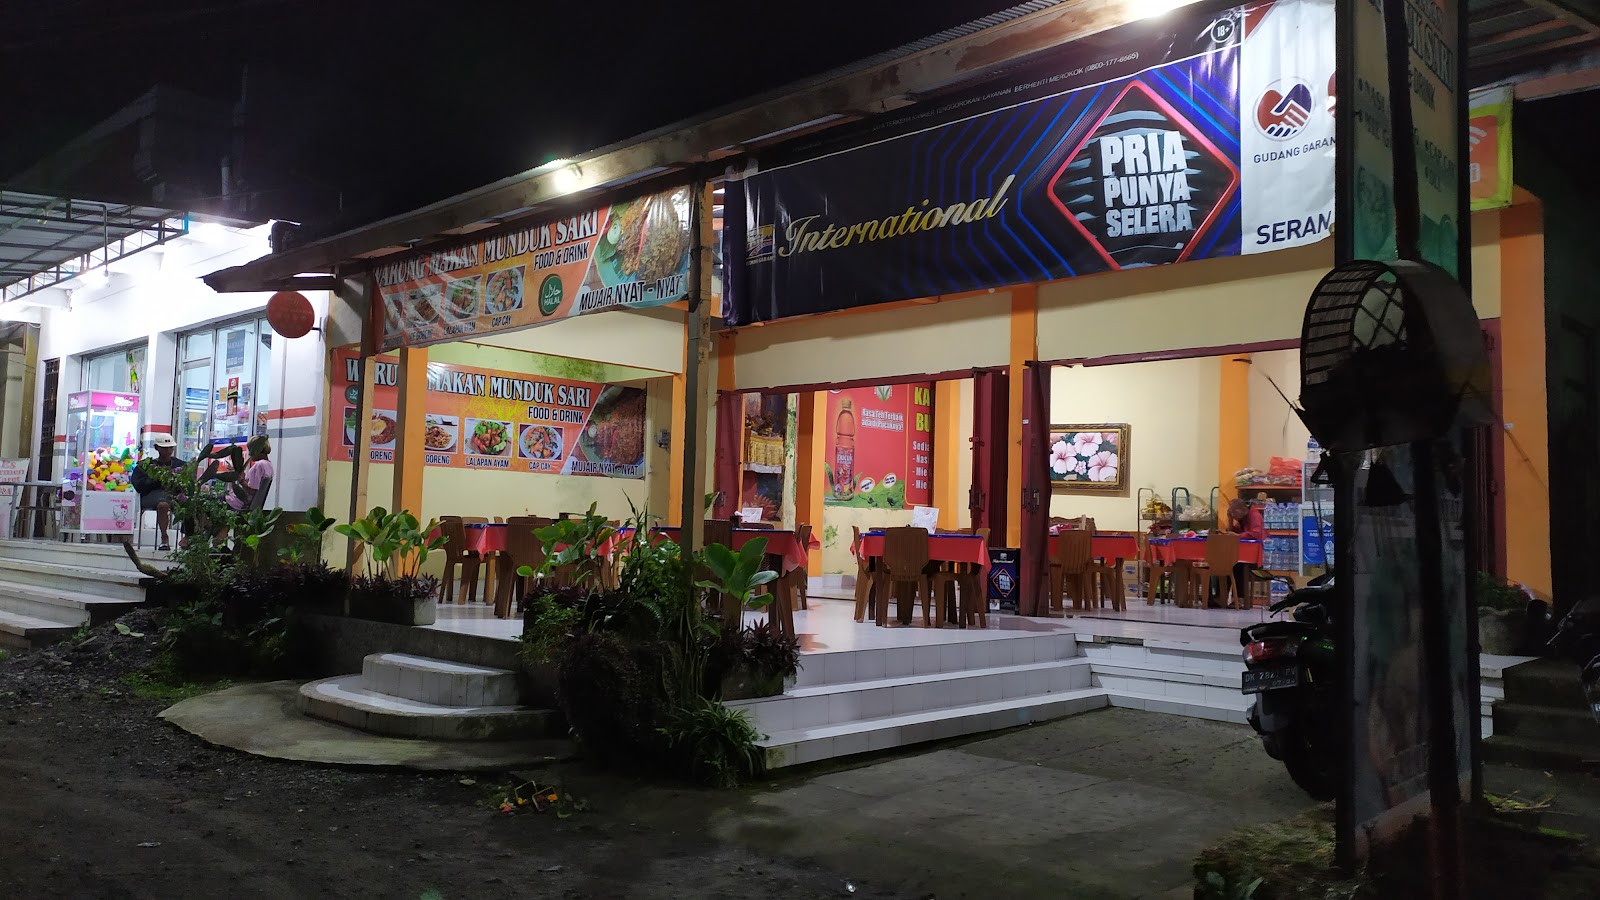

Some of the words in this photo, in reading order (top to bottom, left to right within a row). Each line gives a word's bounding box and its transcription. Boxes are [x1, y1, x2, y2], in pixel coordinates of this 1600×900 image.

[1217, 25, 1230, 37] 18+
[1049, 68, 1083, 83] MEROKOK
[1100, 131, 1187, 176] PRIA
[1253, 147, 1300, 163] GUDANG
[1104, 172, 1191, 207] PUNYA
[778, 174, 1015, 257] International
[1105, 203, 1195, 238] SELERA
[483, 222, 551, 265] MUNDUK
[534, 250, 554, 270] FOOD
[555, 249, 561, 265] &
[563, 242, 589, 264] DRINK
[580, 286, 612, 311] MUJAIR
[615, 281, 644, 304] NYAT
[657, 275, 683, 299] NYAT
[492, 317, 501, 327] CAP
[502, 315, 512, 326] CAY
[346, 358, 398, 386] WRU
[427, 369, 486, 397] MAKAN
[490, 376, 554, 404] MUNDUK
[558, 384, 591, 408] SARI
[914, 386, 930, 406] KA
[528, 406, 550, 419] FOOD
[552, 409, 558, 421] &
[560, 409, 585, 423] DRINK
[913, 440, 929, 451] Sedi
[370, 449, 393, 461] ORENG
[425, 454, 450, 465] GORENG
[466, 457, 492, 467] LALAPAN
[493, 459, 509, 468] AYAM
[529, 461, 540, 470] CAP
[571, 461, 599, 473] MUJAIR
[599, 463, 616, 474] NYAT
[620, 465, 638, 476] NYAT
